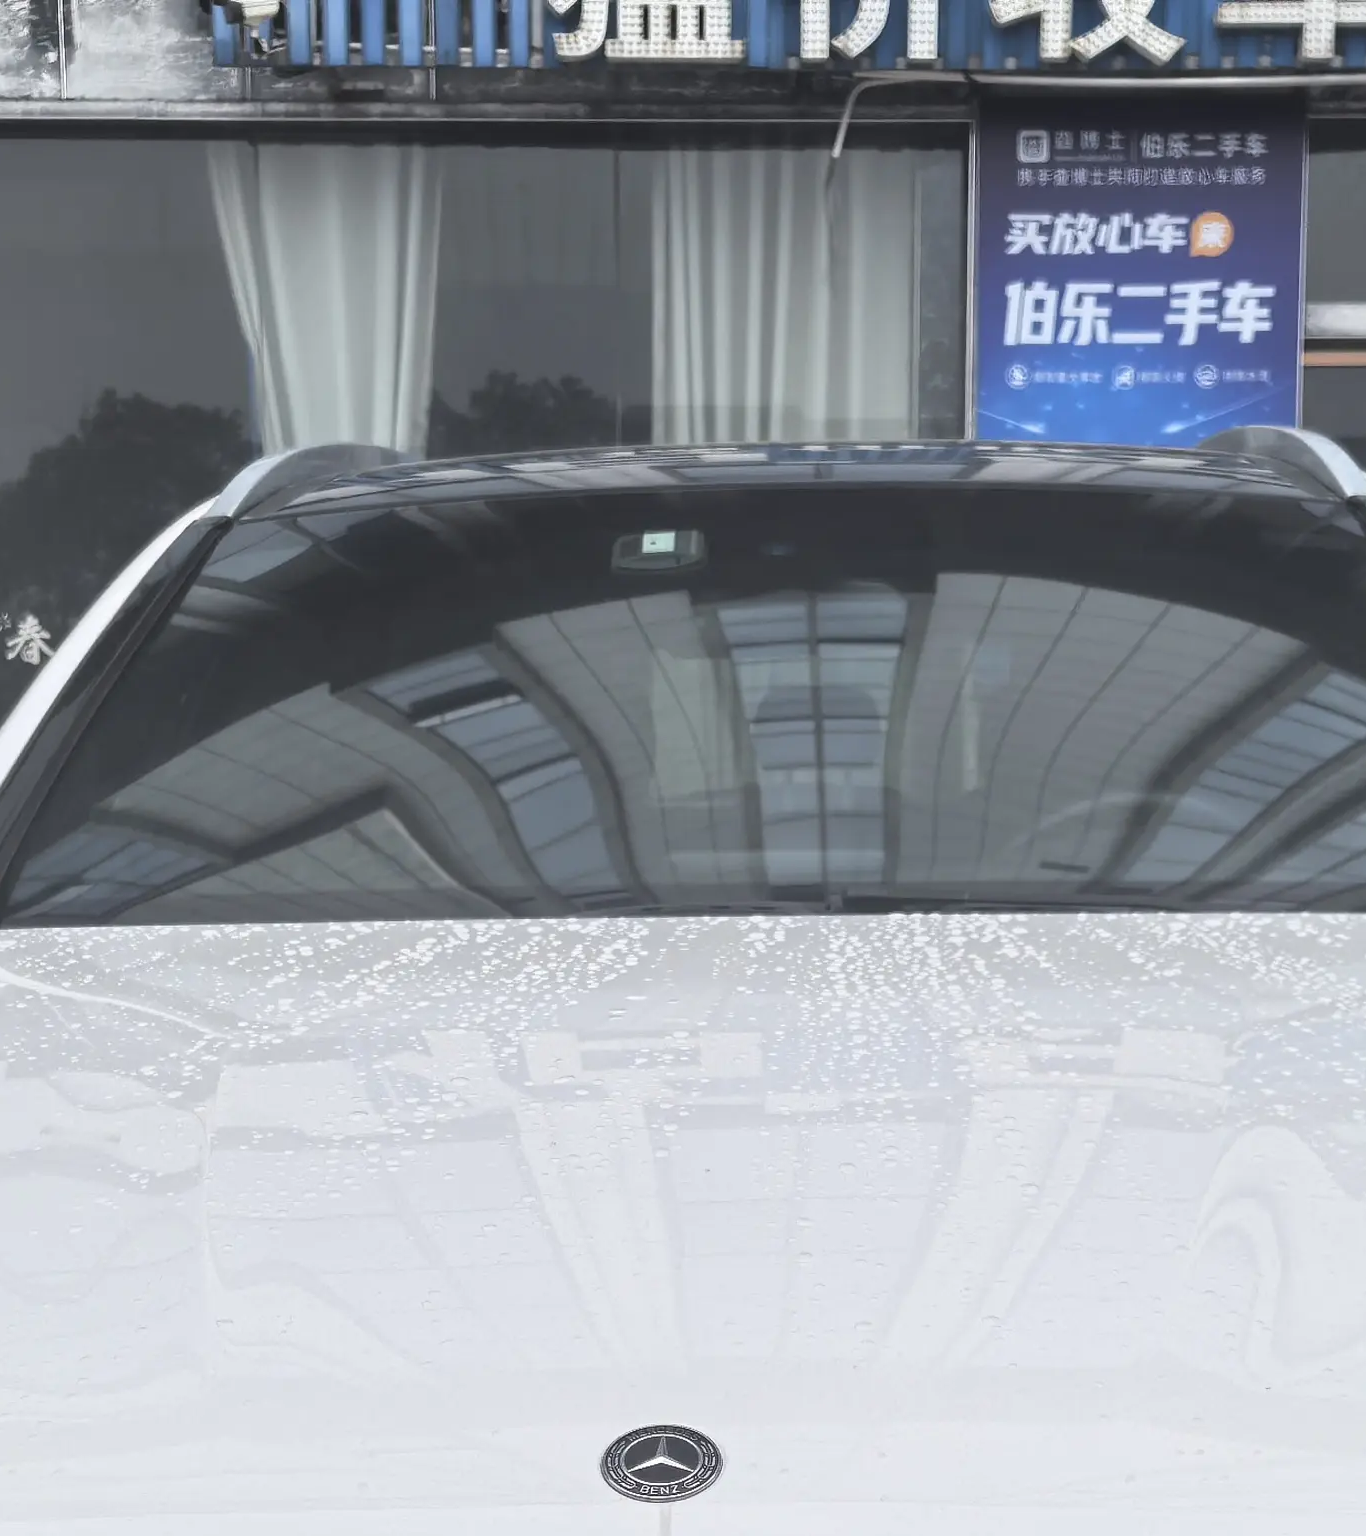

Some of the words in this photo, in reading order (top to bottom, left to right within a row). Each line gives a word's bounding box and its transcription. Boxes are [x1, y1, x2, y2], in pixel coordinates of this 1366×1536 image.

[1140, 132, 1269, 159] 伯乐二手车
[1004, 213, 1190, 255] 买放心车
[1003, 281, 1277, 346] 伯乐二手车
[639, 1484, 682, 1495] BENZ
